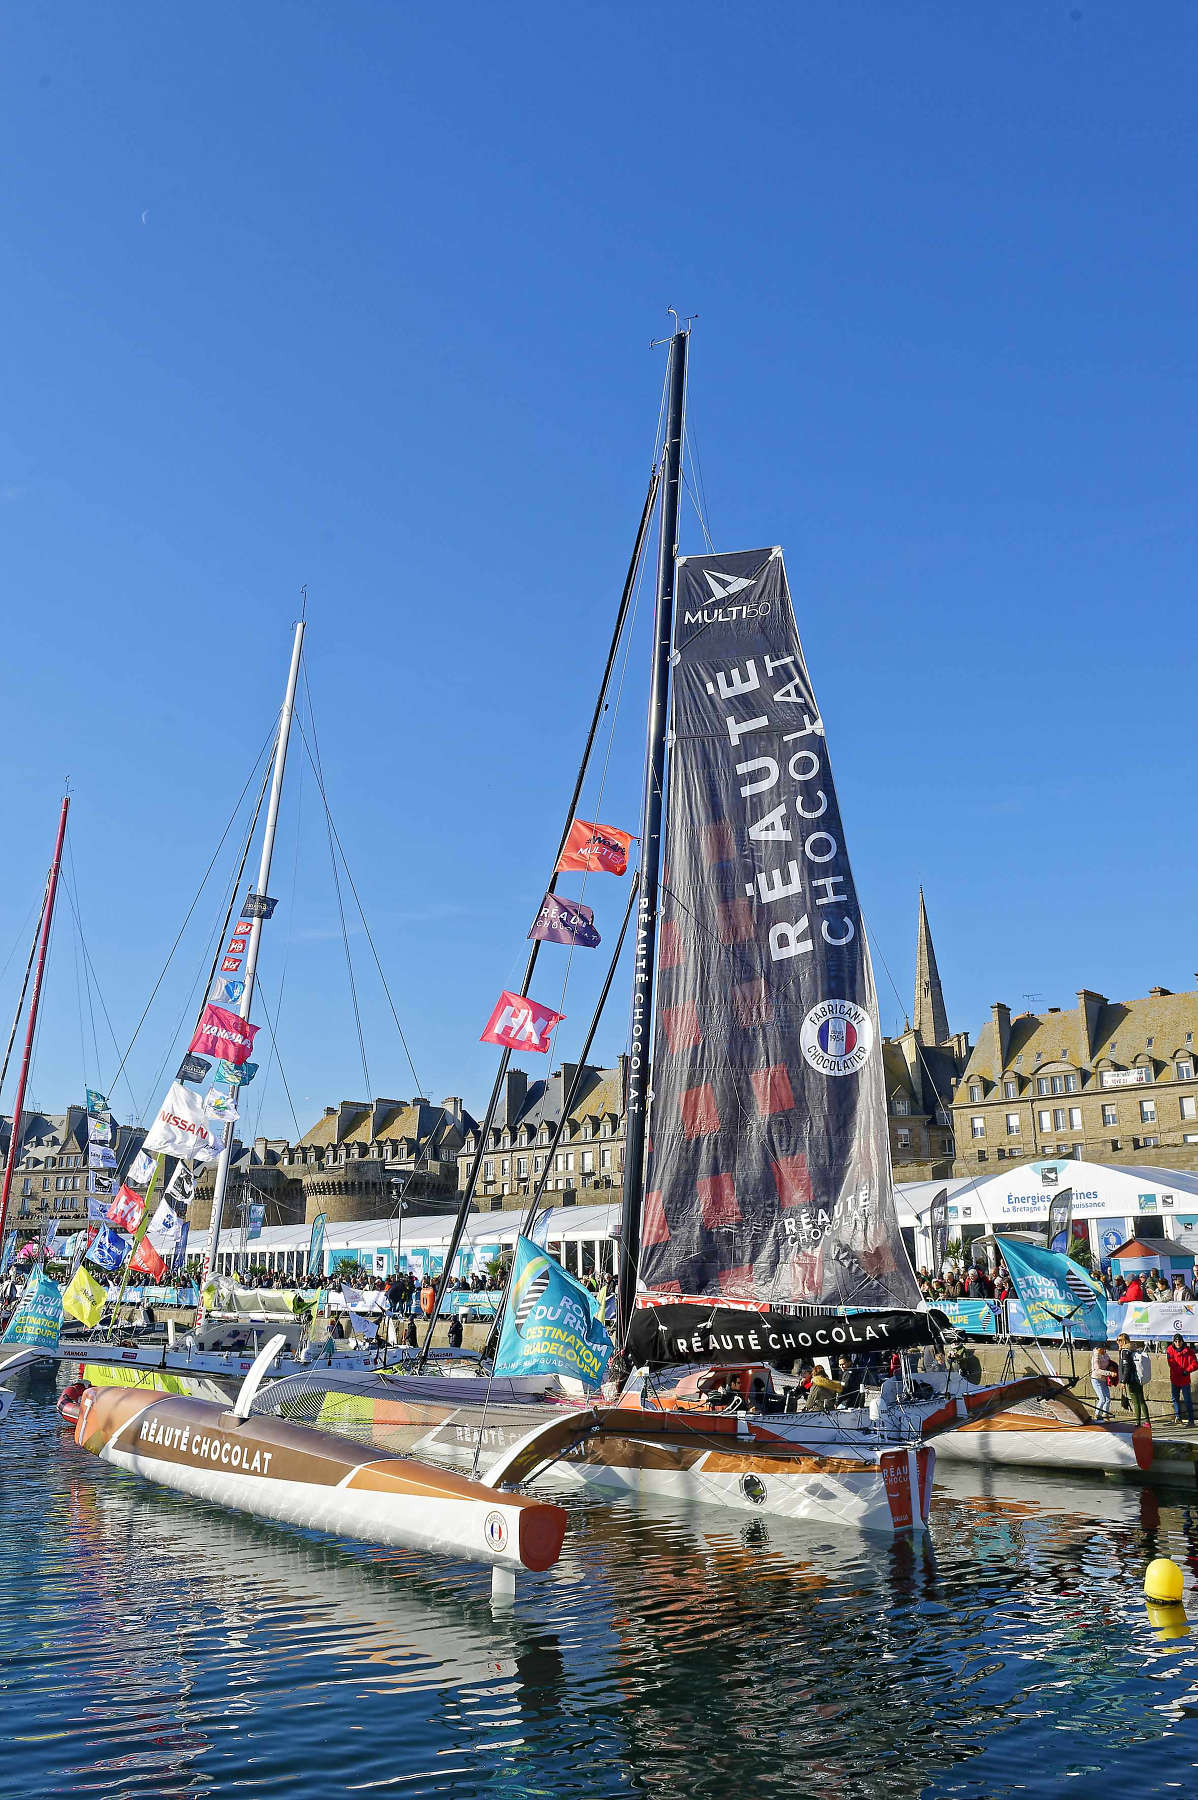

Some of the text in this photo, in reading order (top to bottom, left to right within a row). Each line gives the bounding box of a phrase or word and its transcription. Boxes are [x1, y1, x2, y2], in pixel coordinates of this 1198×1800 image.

[684, 602, 771, 624] MULTI50
[705, 659, 814, 961] RÉAUTÉ
[764, 655, 855, 946] CHOCOLAT
[628, 898, 651, 1114] RÉAUTÉ CHOCOLAT
[809, 1004, 865, 1025] FABRICANT
[807, 1045, 867, 1071] CHOCOLATIER
[160, 1110, 209, 1139] NISSAN
[784, 1184, 870, 1235] RÉAUTÉ
[1007, 1192, 1051, 1206] Énergies
[1012, 1205, 1040, 1214] Bretagne
[535, 1306, 561, 1321] DU
[526, 1326, 602, 1372] DESTINATION
[677, 1323, 890, 1353] RÉAUTÉ CHOCOLAT
[523, 1341, 598, 1380] GUADELOUPE
[140, 1418, 272, 1475] RÉAUTÉ CHOCOLAT
